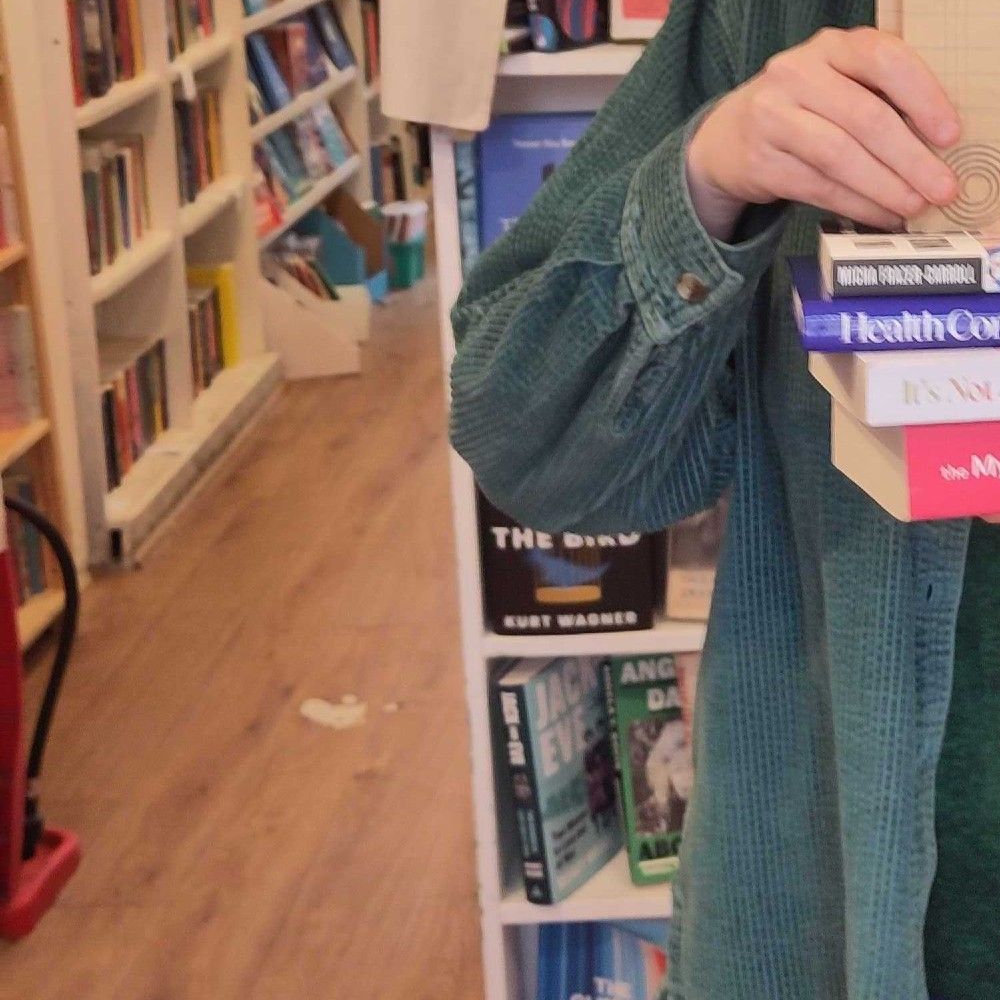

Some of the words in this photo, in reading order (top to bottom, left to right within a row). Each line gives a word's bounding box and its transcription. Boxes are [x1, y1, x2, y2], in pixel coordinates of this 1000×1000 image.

[839, 310, 946, 344] Health
[938, 463, 970, 481] the
[491, 526, 553, 550] THE
[503, 614, 551, 629] KURT
[557, 610, 638, 628] WAGNER
